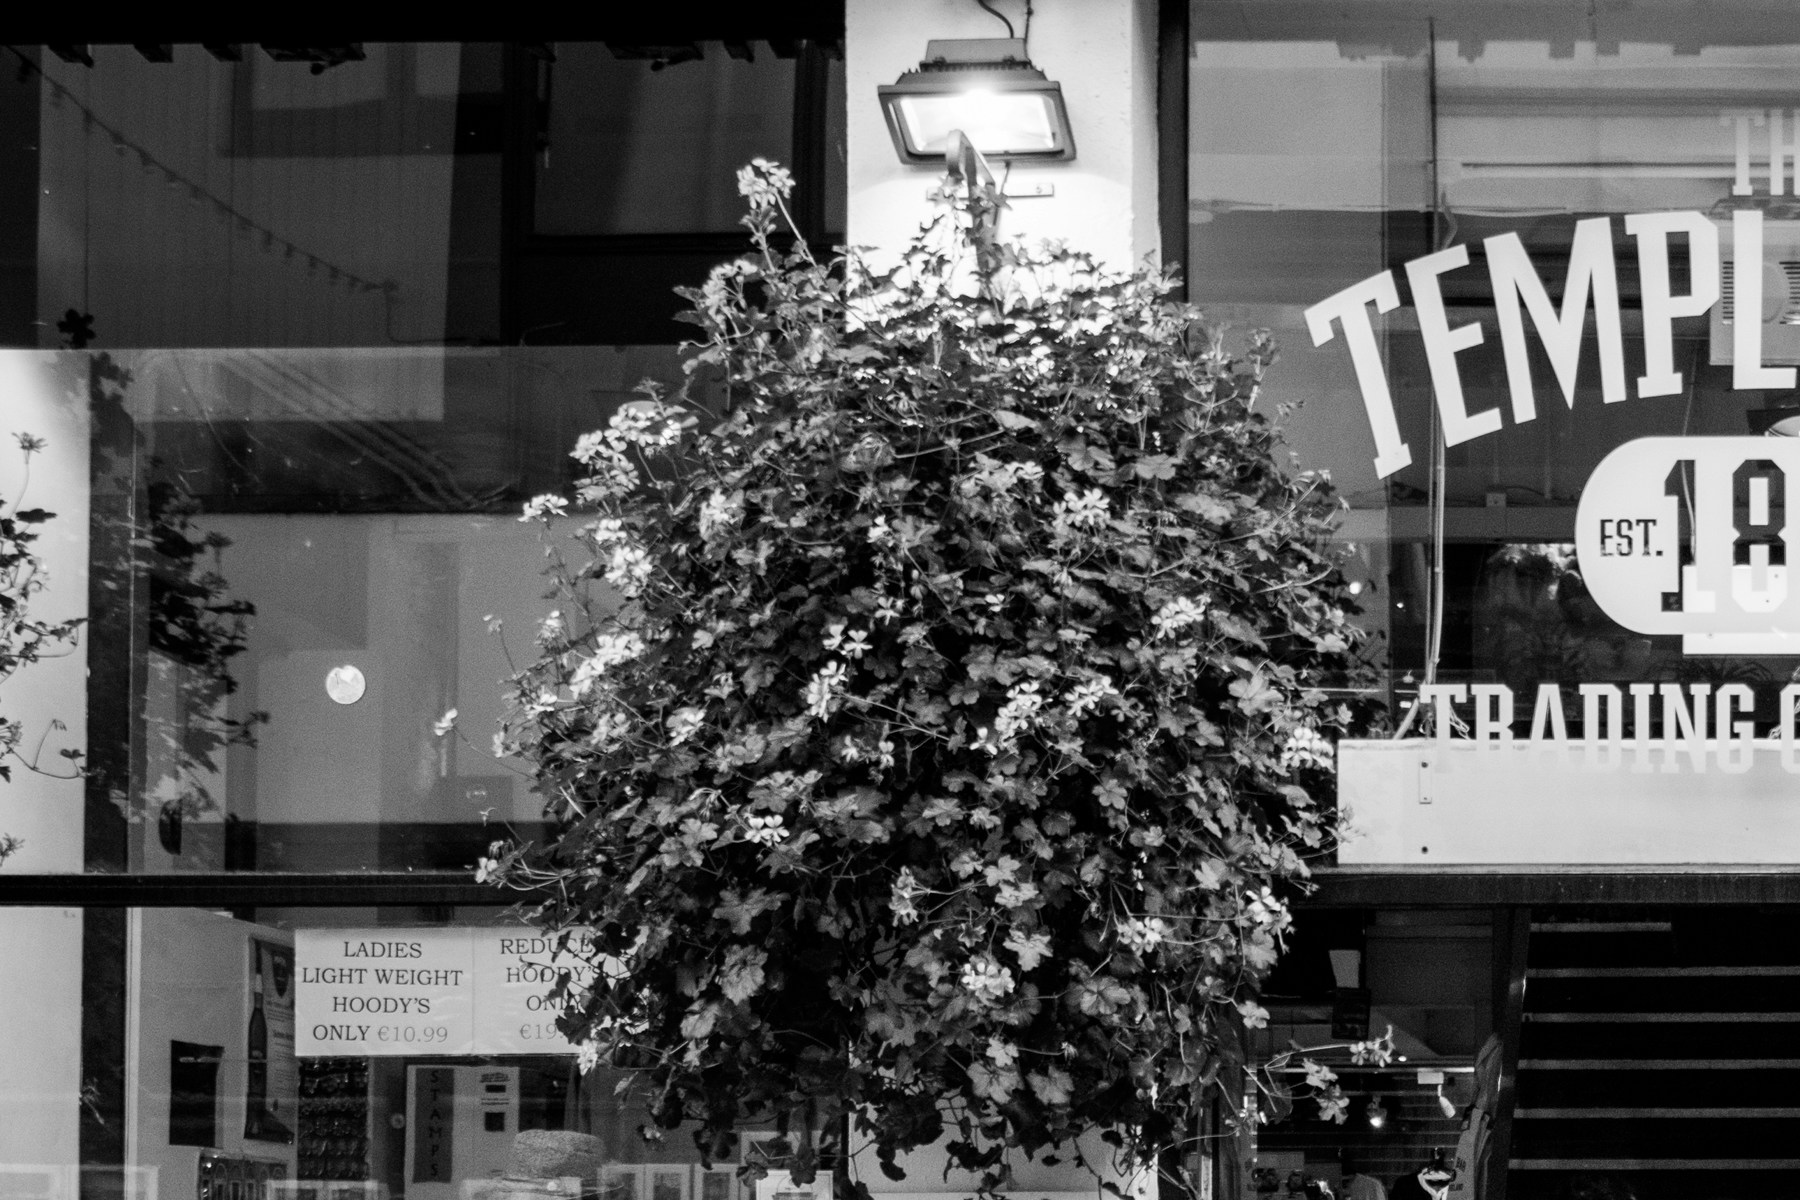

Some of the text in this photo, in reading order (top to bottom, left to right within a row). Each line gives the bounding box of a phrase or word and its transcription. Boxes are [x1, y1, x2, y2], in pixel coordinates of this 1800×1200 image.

[1598, 518, 1664, 559] EST.
[1418, 683, 1753, 773] TRADING
[344, 941, 423, 959] LADIES
[302, 967, 464, 986] LIGHT WEIGHT
[332, 996, 431, 1014] HOODY'S
[312, 1024, 449, 1043] ONLY €10.99
[428, 1069, 442, 1178] STAMPS
